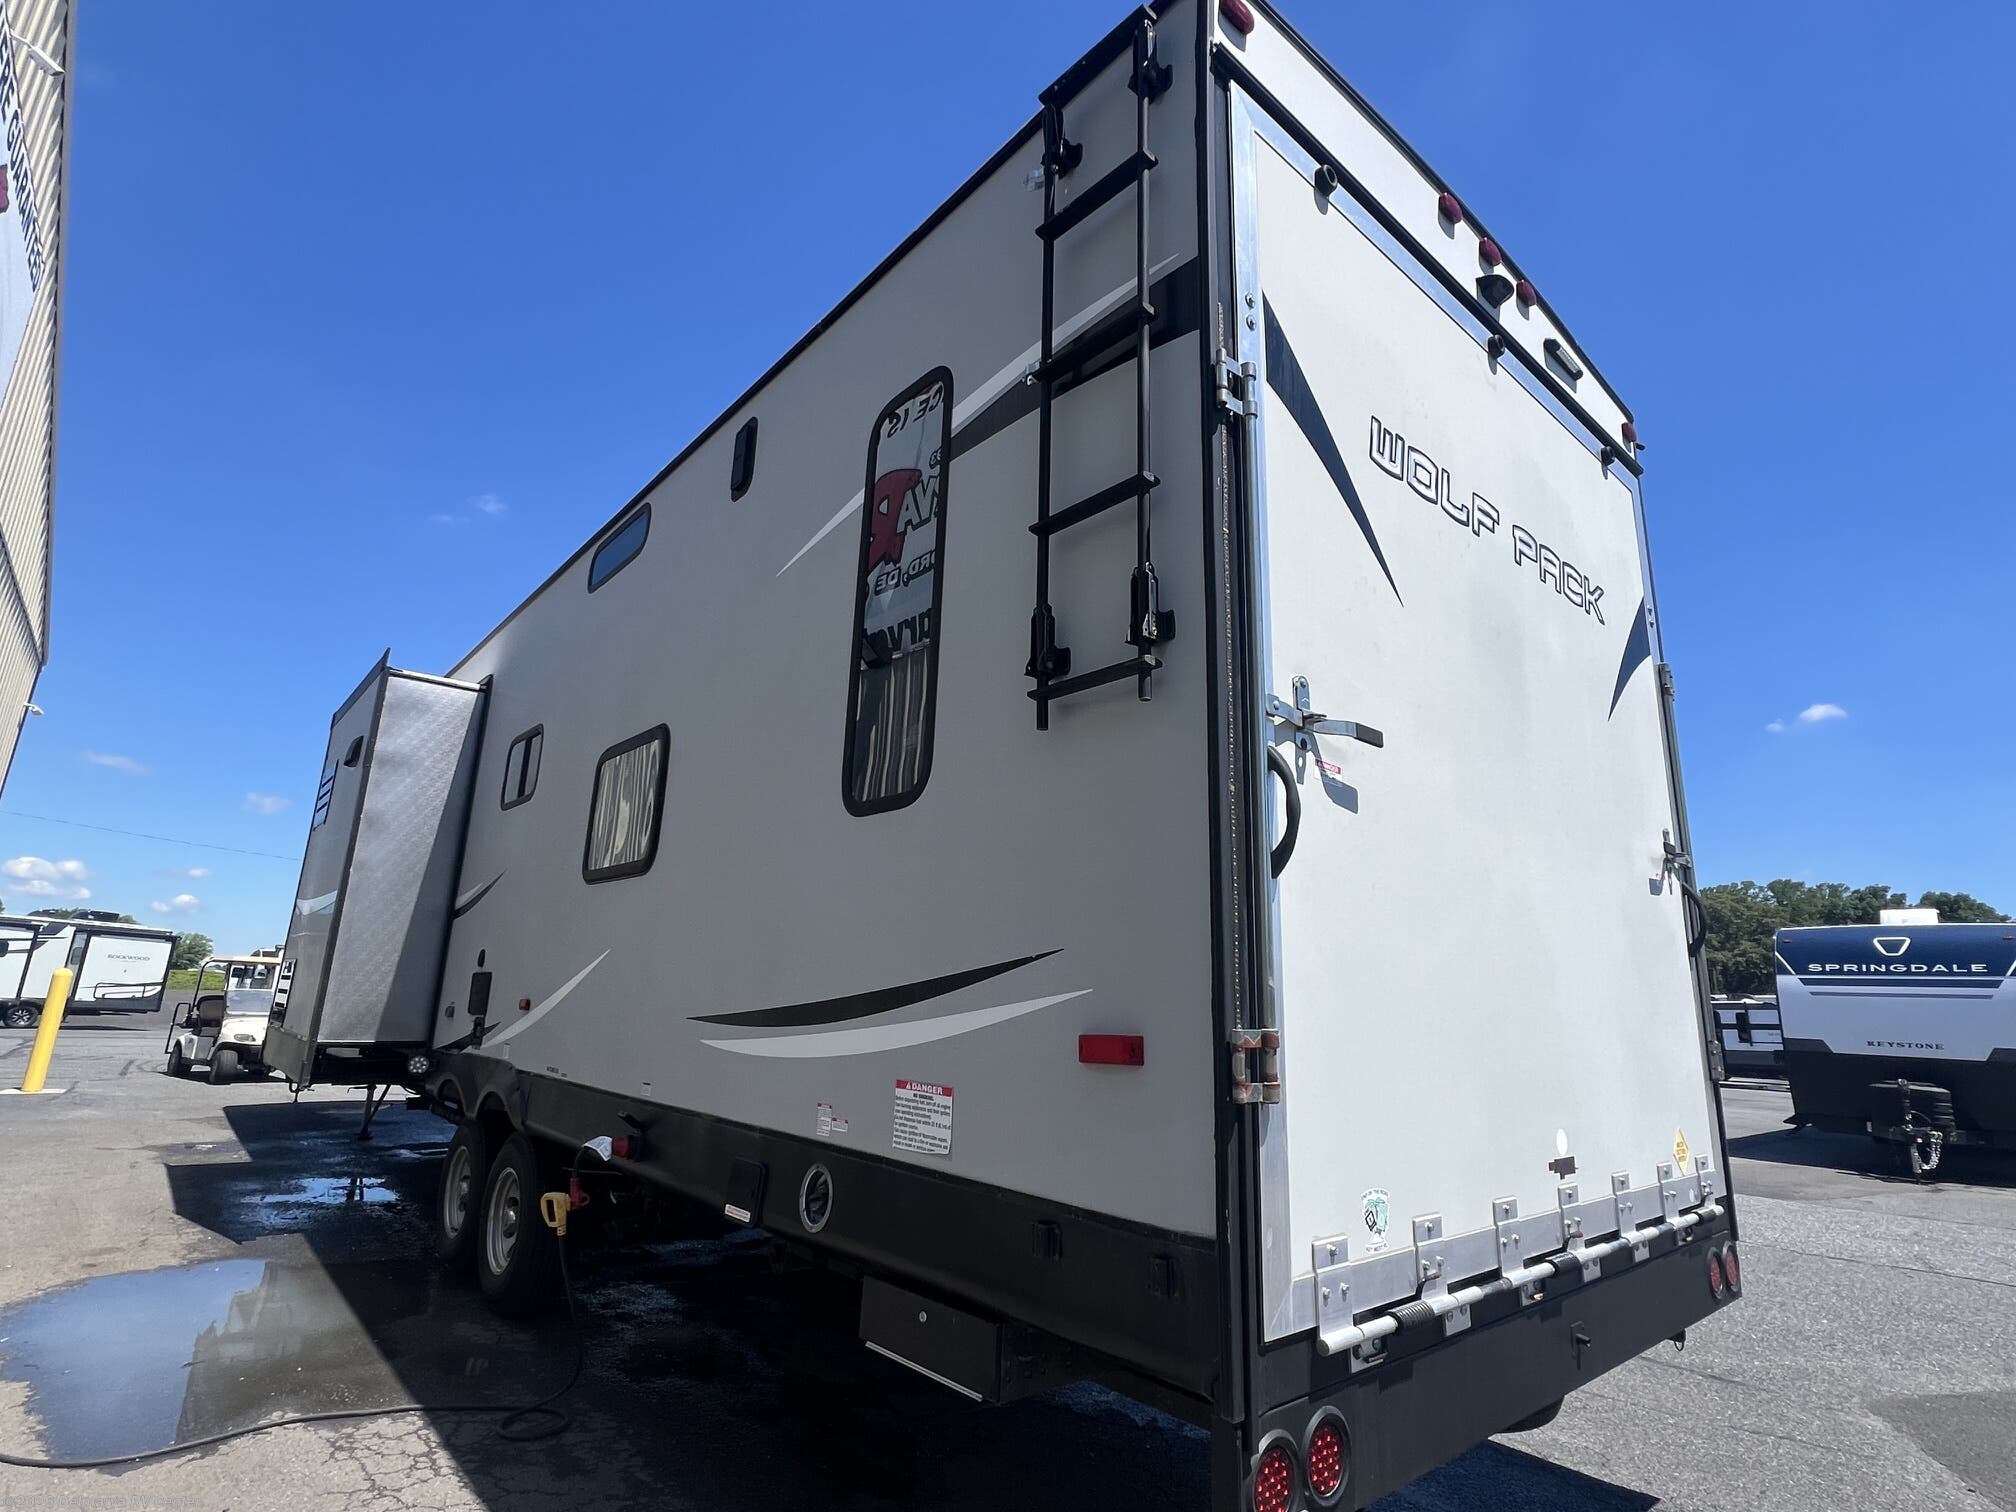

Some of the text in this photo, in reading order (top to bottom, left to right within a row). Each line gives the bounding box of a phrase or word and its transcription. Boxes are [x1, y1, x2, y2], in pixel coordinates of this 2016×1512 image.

[7, 108, 41, 293] GUARANTEED
[1369, 415, 1605, 626] WOLF PACK
[1807, 963, 1988, 973] SPRINGDALE
[1866, 1040, 1945, 1051] KEYSTONE
[911, 1082, 943, 1095] DANGER
